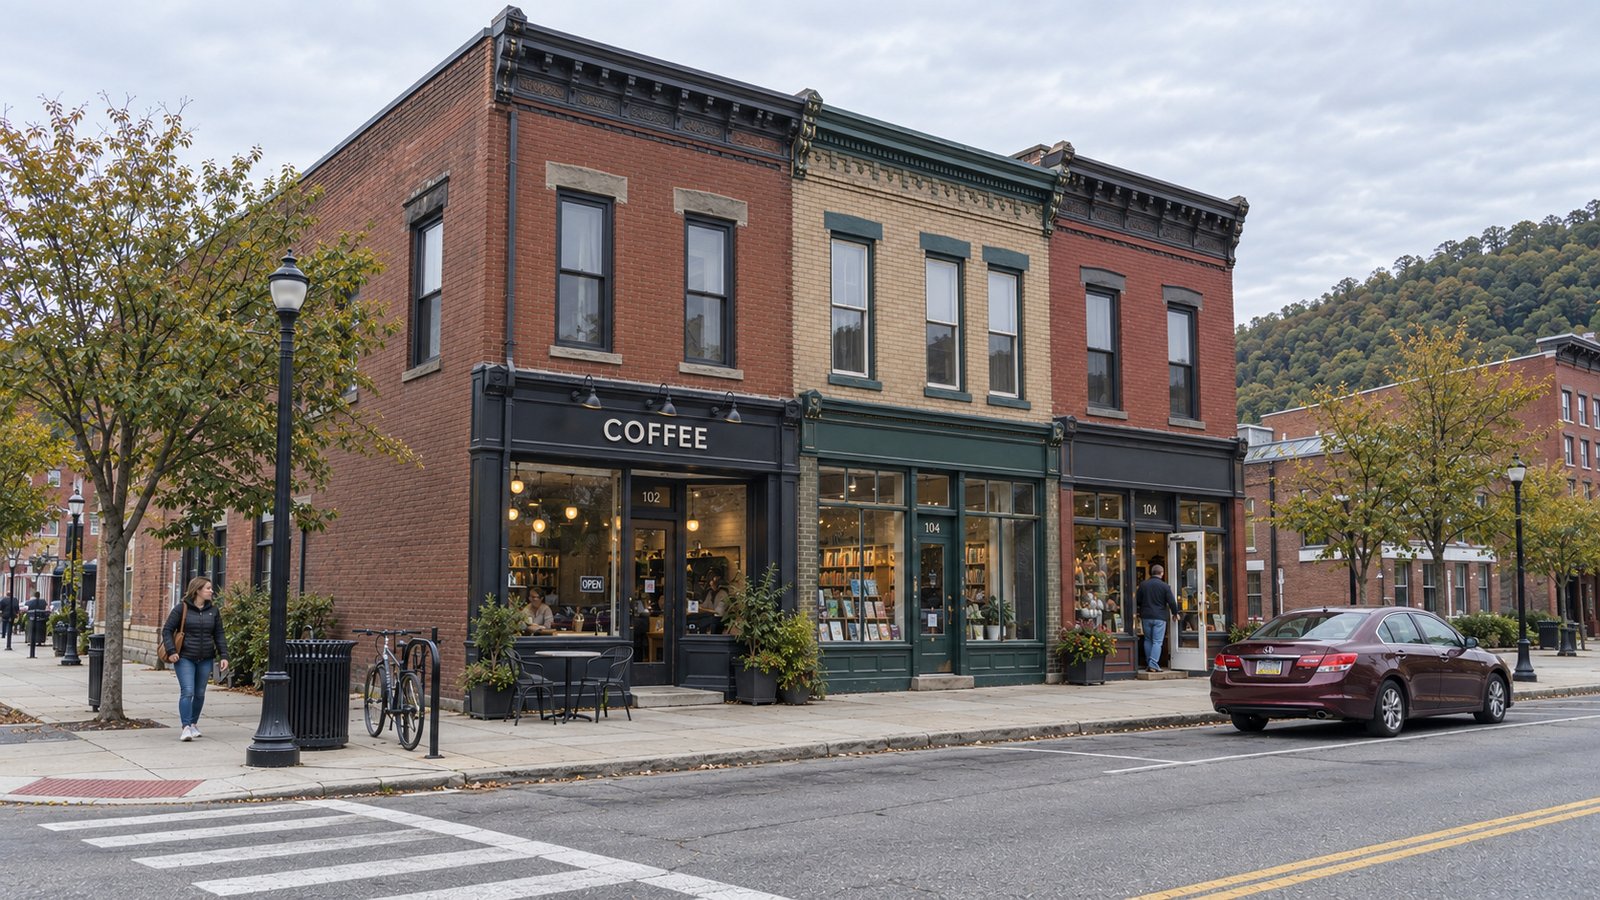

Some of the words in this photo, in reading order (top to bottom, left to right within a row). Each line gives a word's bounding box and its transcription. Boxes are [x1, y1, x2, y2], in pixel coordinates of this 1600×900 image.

[603, 418, 708, 450] COFFEE
[642, 491, 660, 503] 102
[1143, 504, 1157, 515] 104
[924, 522, 940, 533] 104
[582, 579, 602, 589] OPEN
